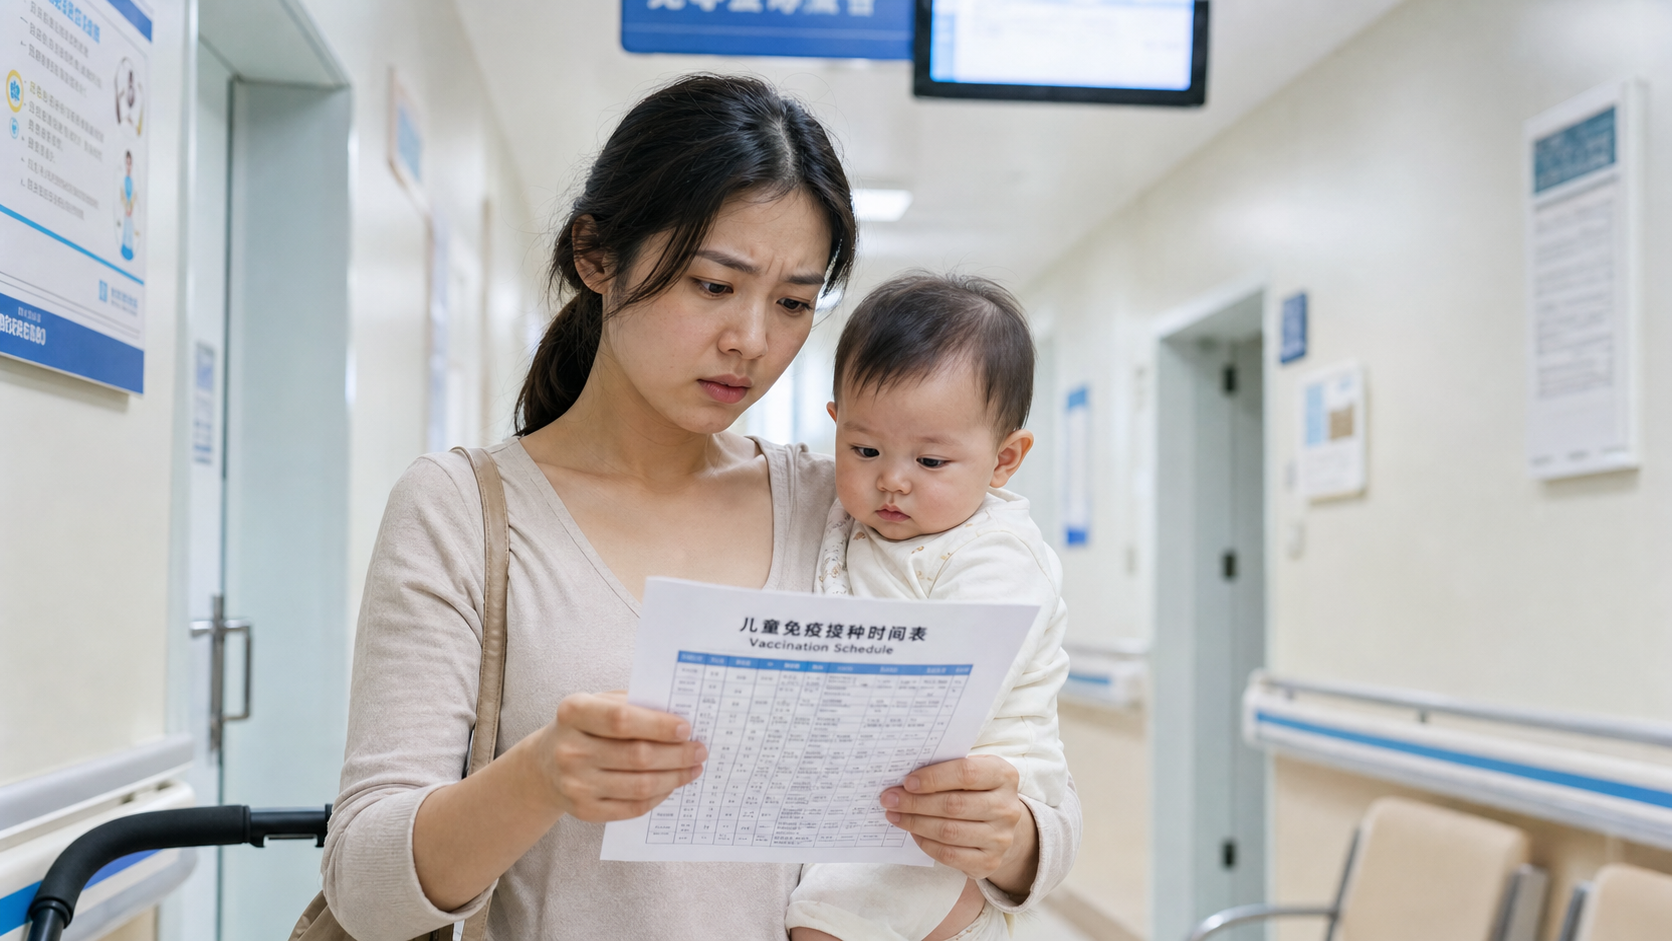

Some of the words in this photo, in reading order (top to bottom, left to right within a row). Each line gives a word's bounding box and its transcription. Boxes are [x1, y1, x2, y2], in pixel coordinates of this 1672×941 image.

[740, 617, 928, 642] 儿童免疫接种时间表
[749, 637, 829, 653] Vaccination
[834, 643, 894, 655] Schedule
